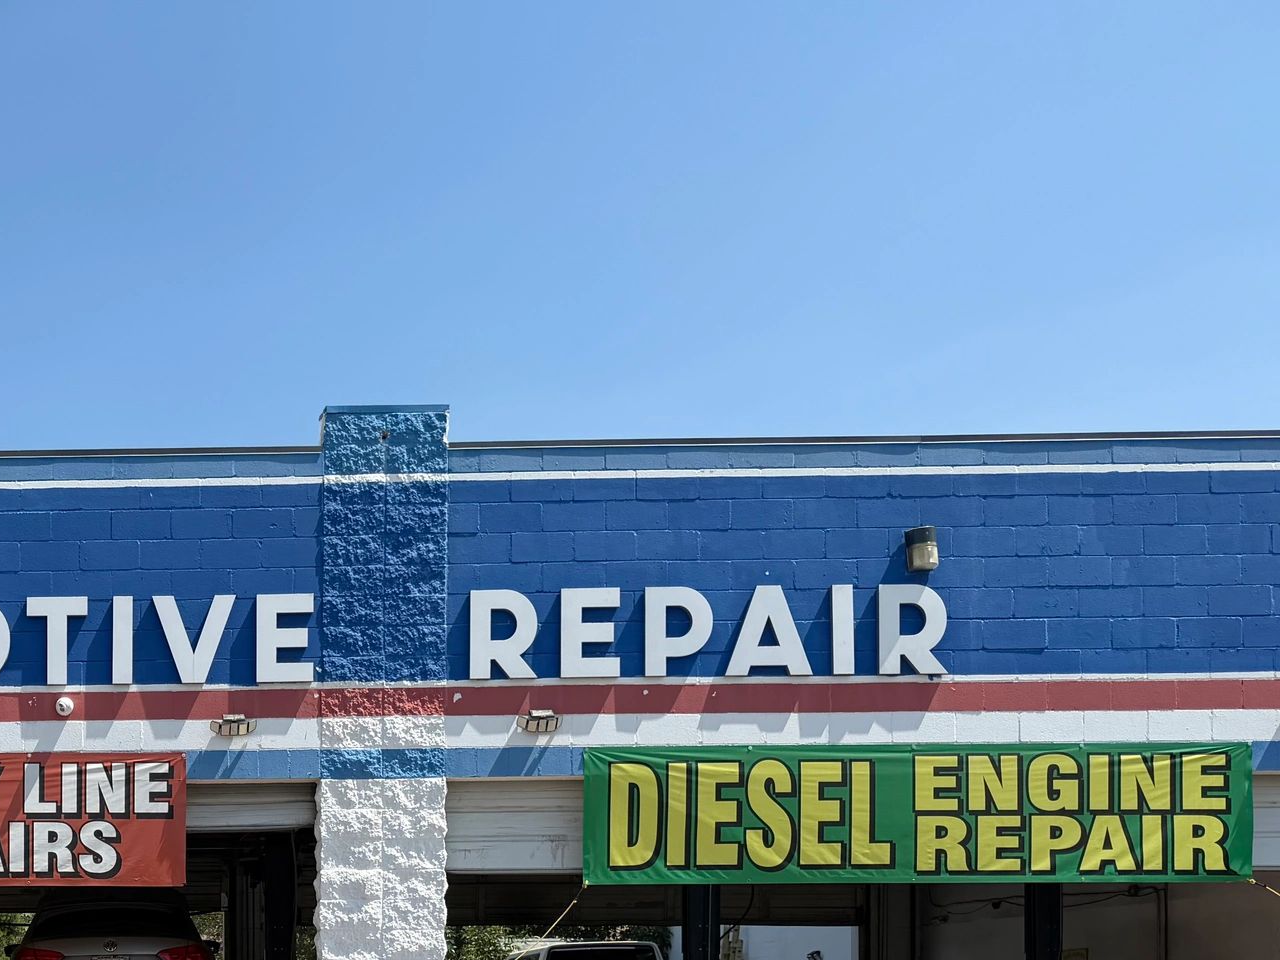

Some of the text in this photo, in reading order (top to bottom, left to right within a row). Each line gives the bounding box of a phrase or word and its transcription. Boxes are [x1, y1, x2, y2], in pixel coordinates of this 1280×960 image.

[469, 584, 948, 680] REPAIR
[23, 761, 173, 817] LINE
[914, 753, 1229, 812] ENGINE
[608, 760, 894, 869] DIESEL
[916, 814, 1230, 872] REPAIR
